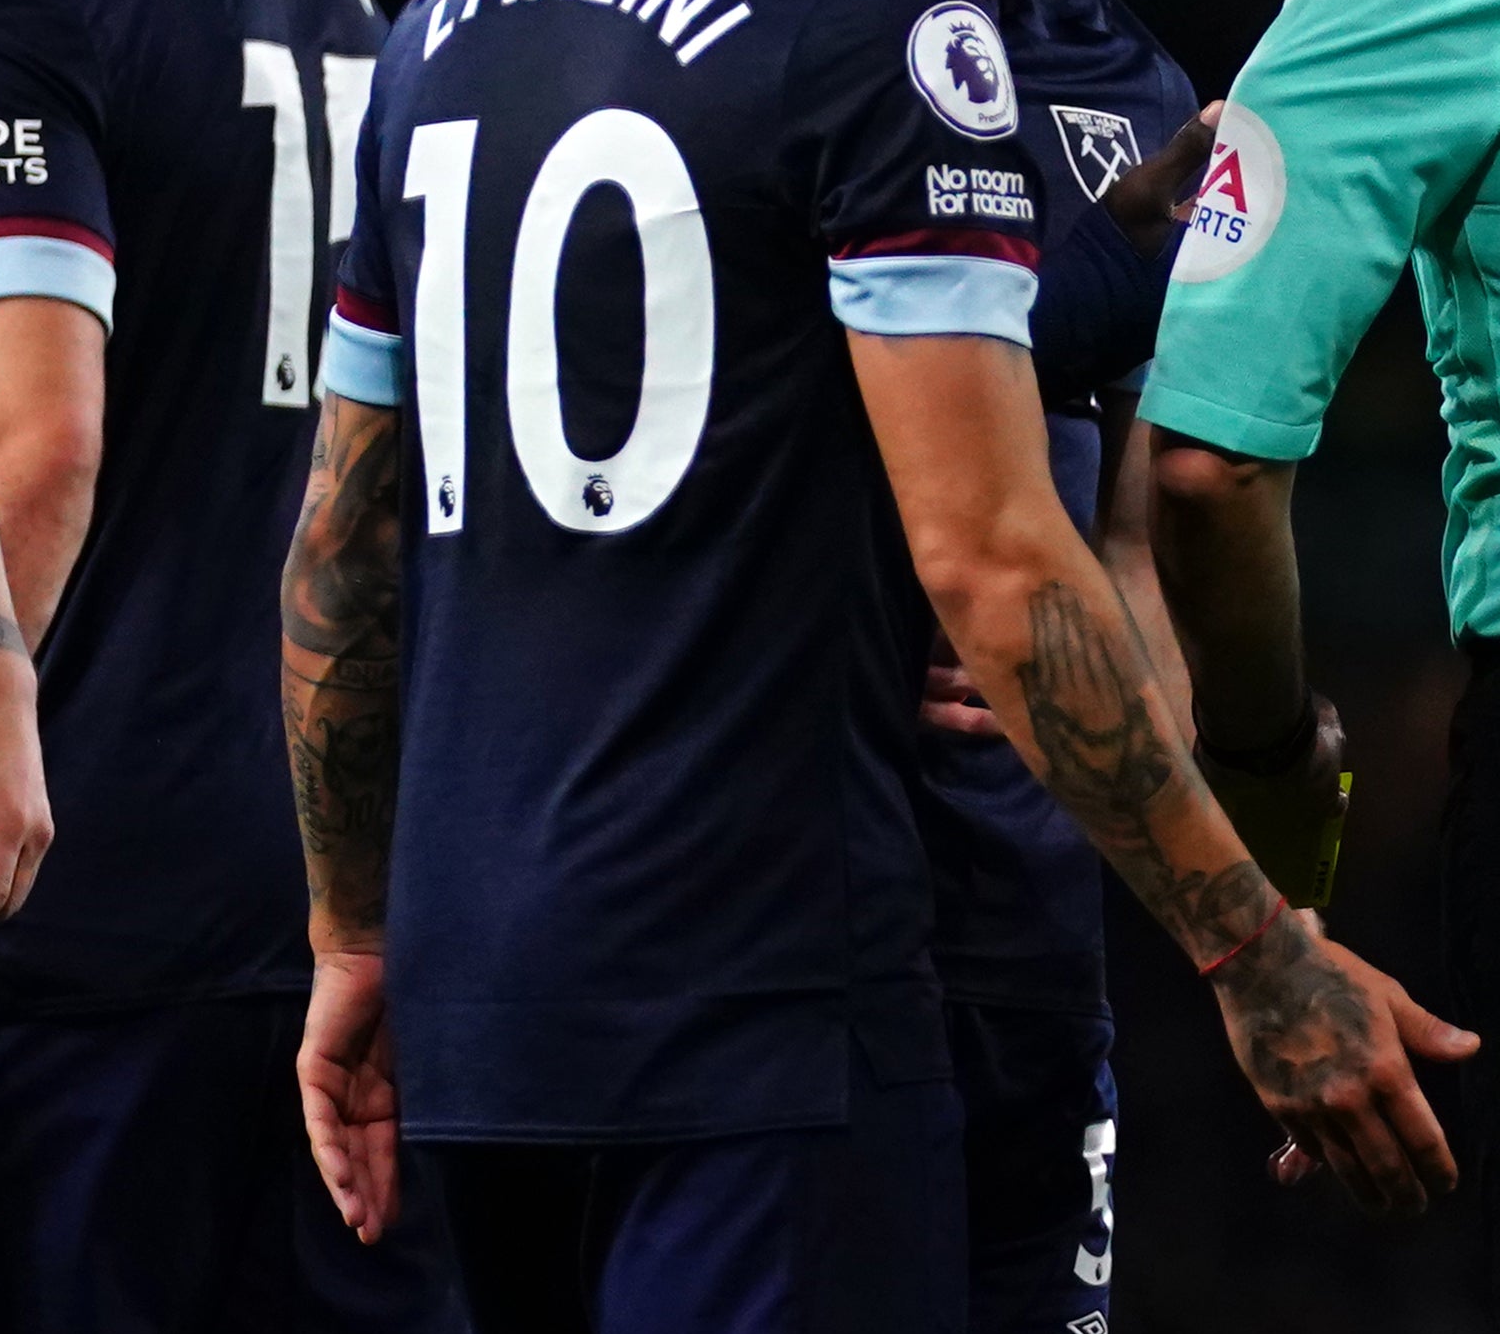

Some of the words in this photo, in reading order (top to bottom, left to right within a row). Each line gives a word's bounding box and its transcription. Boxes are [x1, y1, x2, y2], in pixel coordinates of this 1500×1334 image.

[926, 164, 967, 191] No
[971, 169, 1025, 195] room
[1197, 142, 1248, 214] A
[971, 192, 1035, 221] racism
[400, 107, 716, 535] 10
